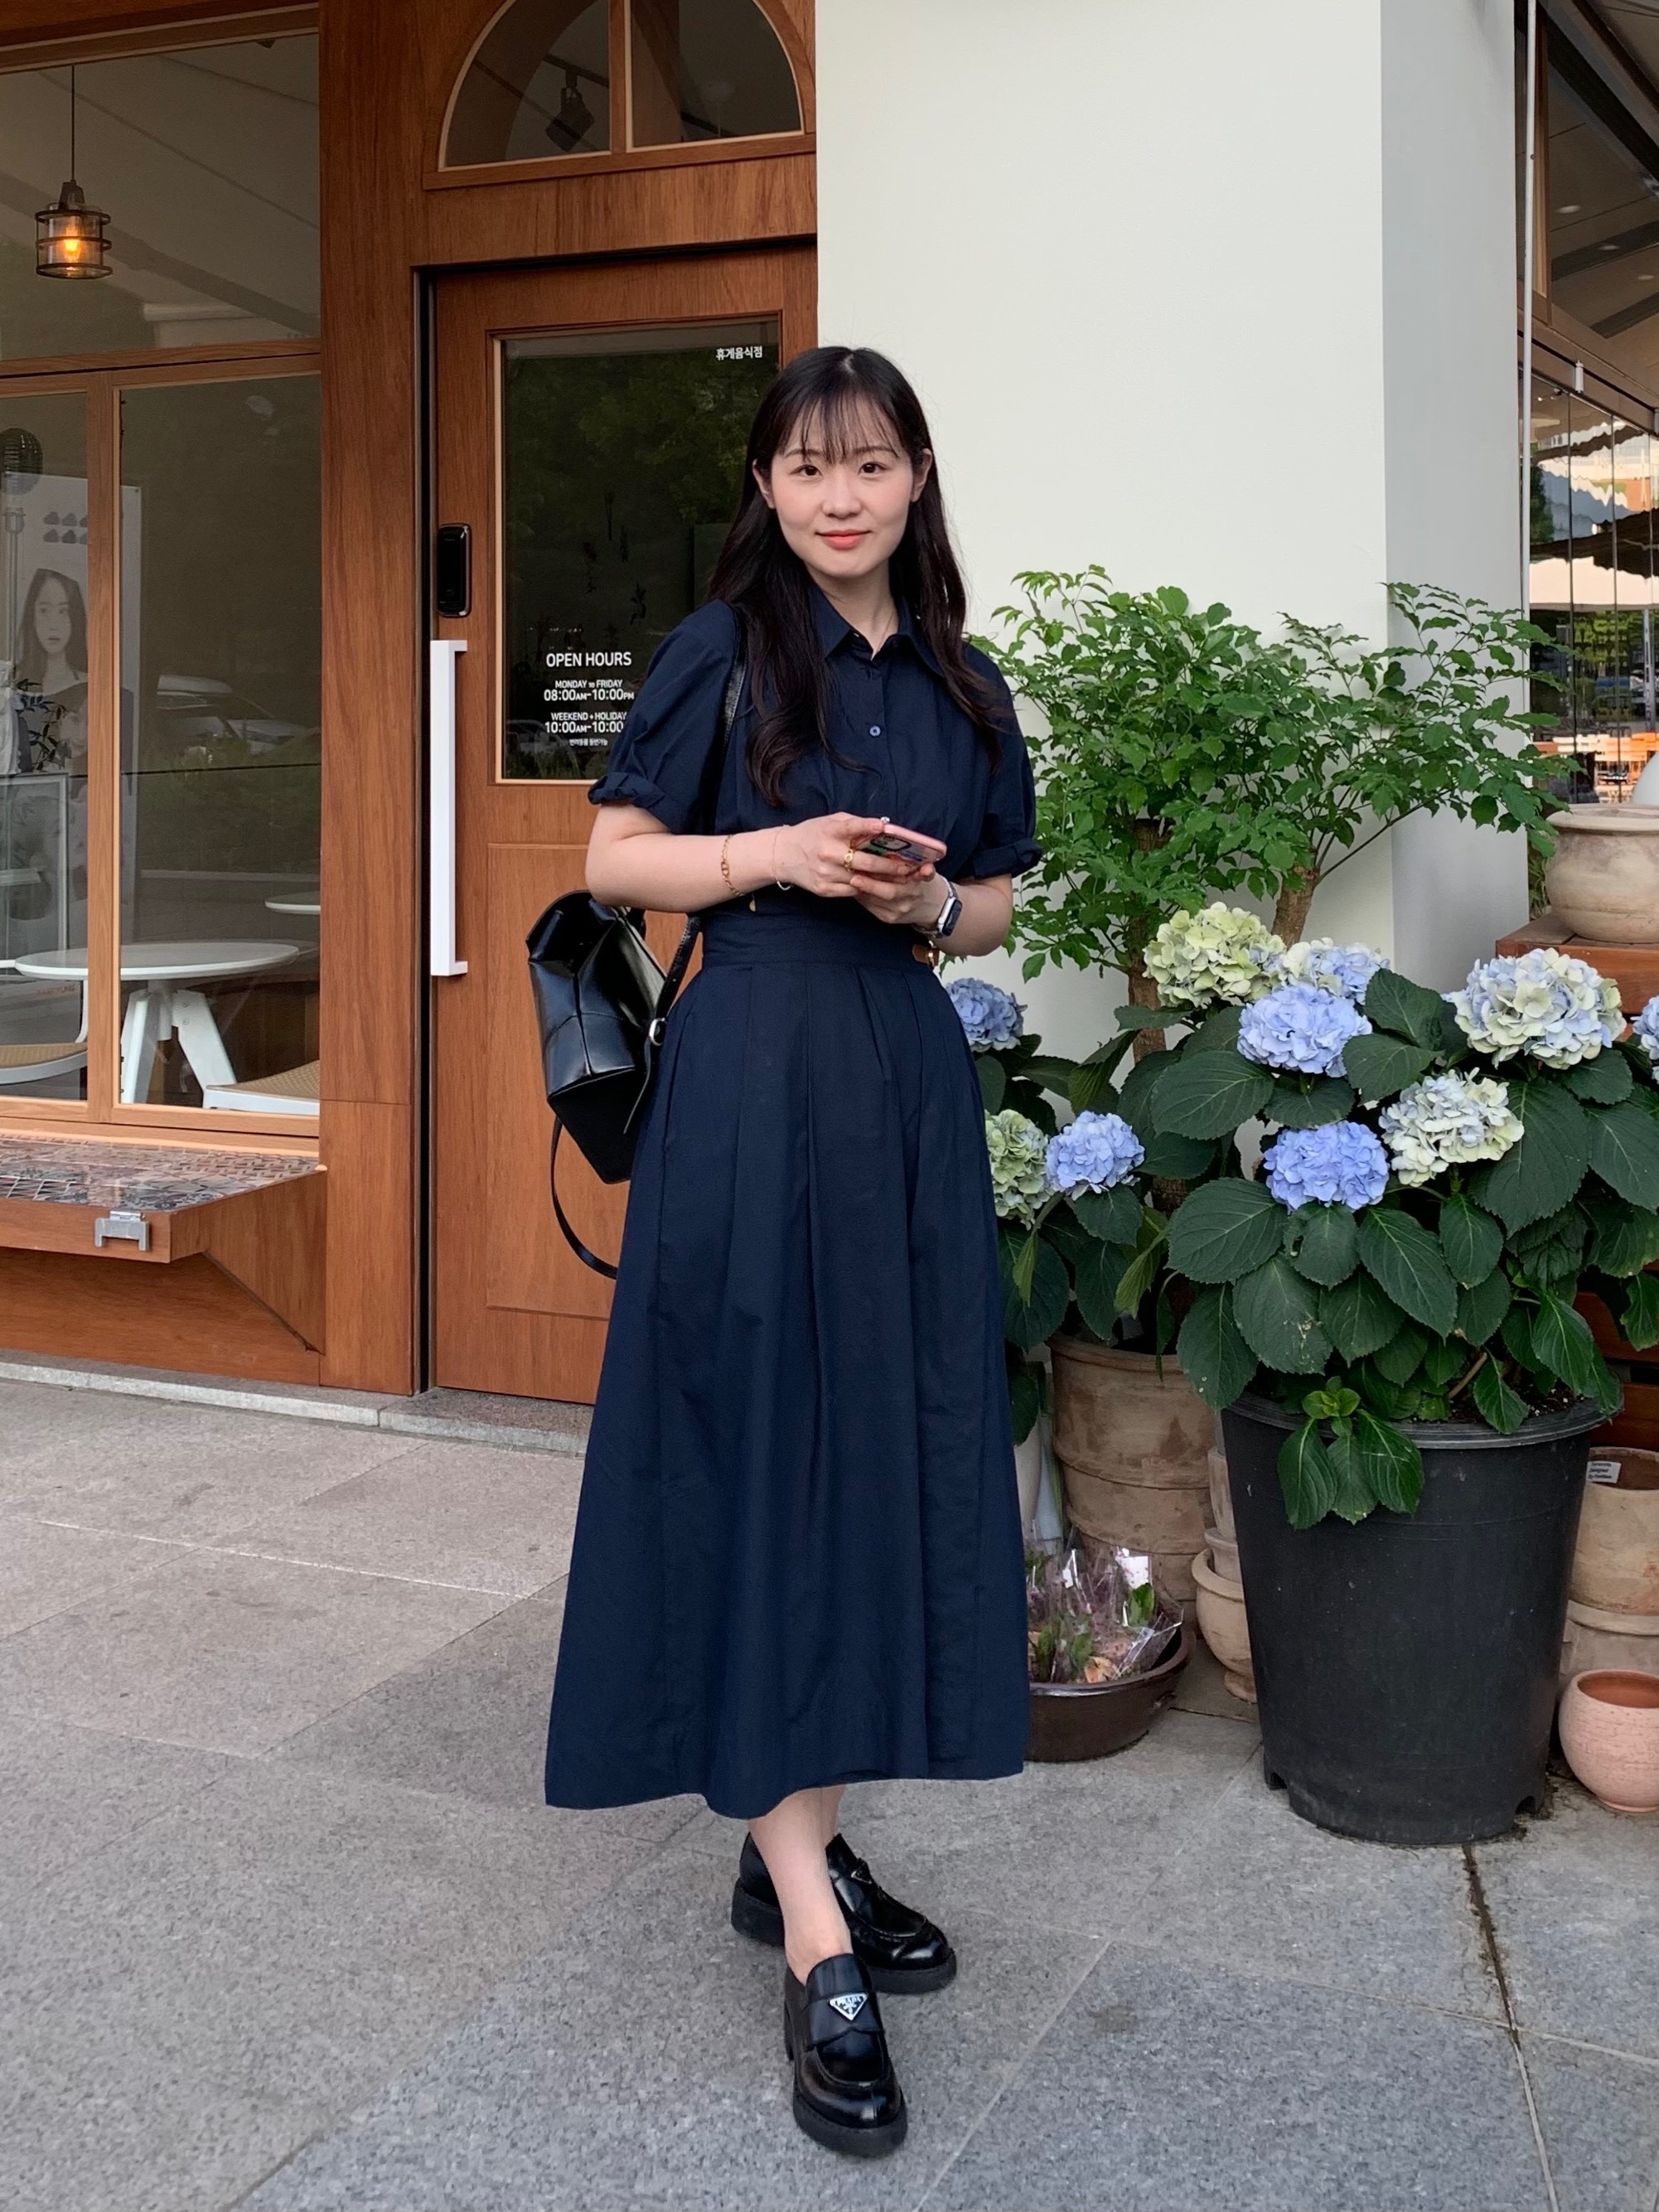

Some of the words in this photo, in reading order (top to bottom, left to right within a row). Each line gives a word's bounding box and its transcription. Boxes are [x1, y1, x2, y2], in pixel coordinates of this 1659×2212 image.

[715, 346, 762, 361] 휴게음식점
[546, 653, 582, 667] OPEN
[585, 651, 631, 666] HOURS
[555, 680, 587, 689] MONDAY
[597, 680, 622, 688] FRIDAY
[551, 712, 588, 721] WEEKEND
[594, 712, 626, 720] HOLIDAY
